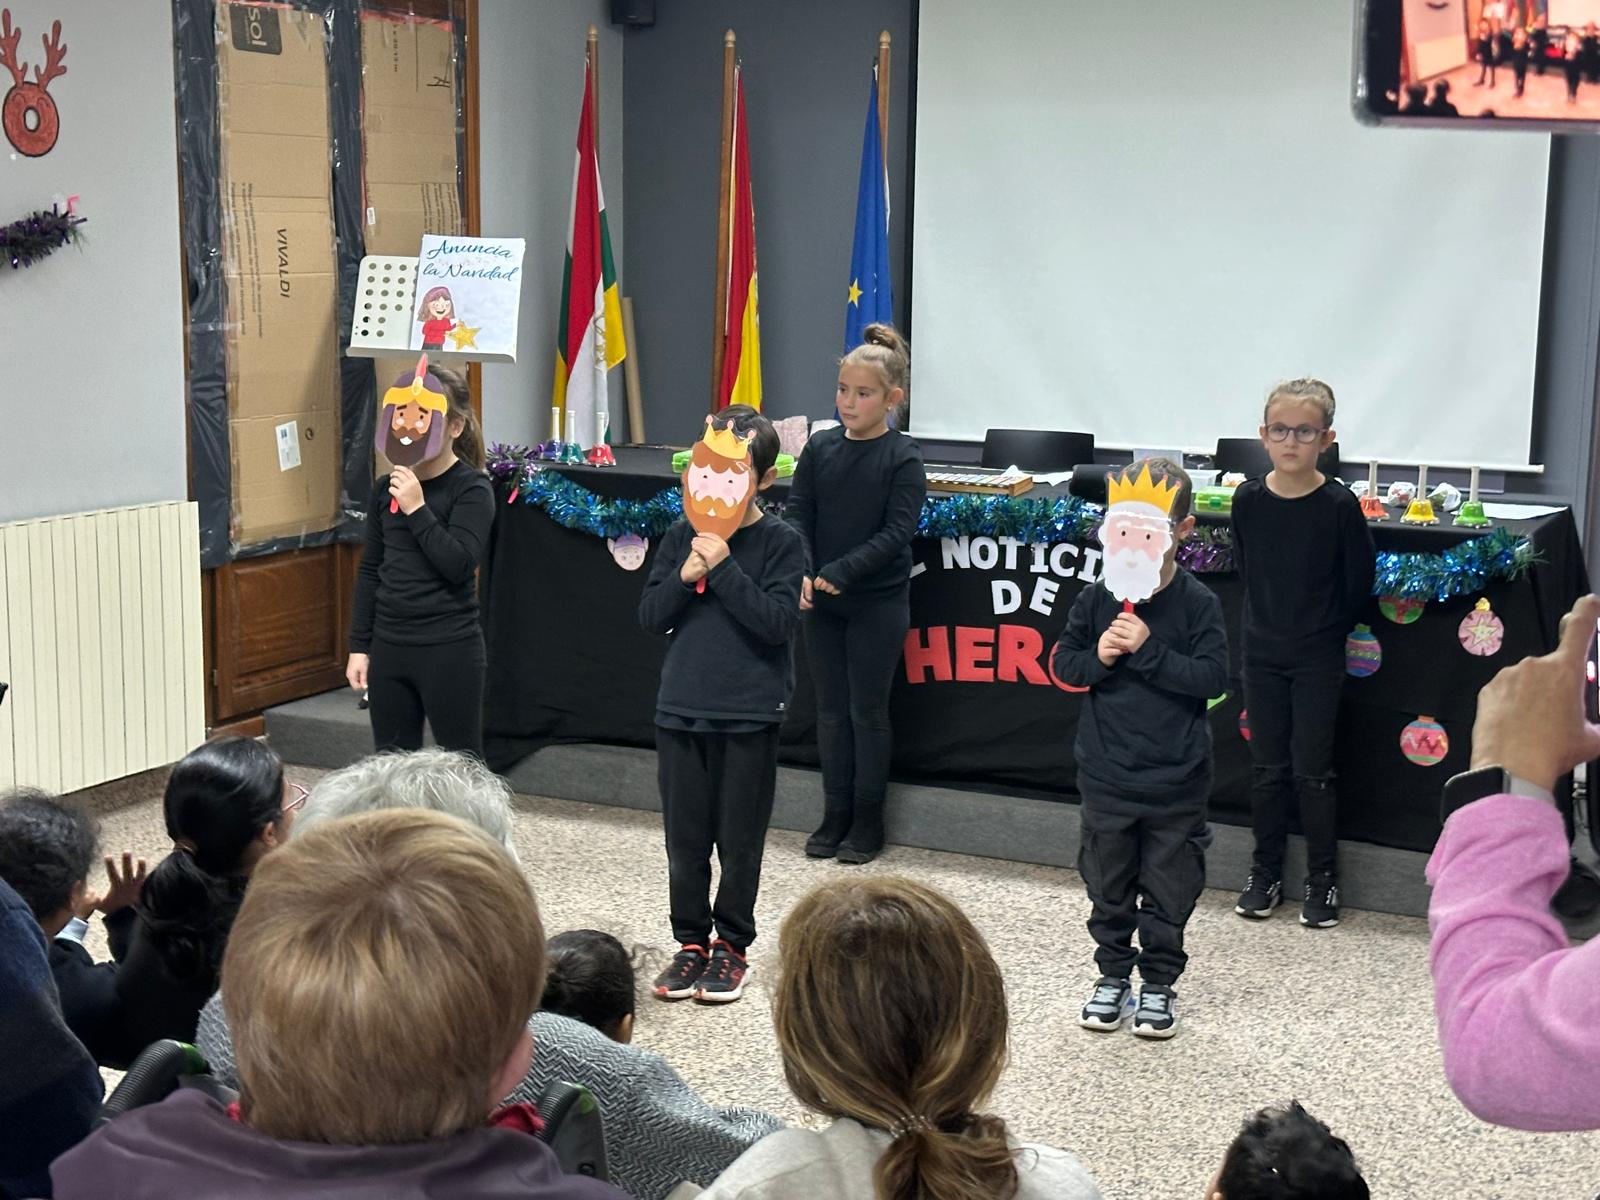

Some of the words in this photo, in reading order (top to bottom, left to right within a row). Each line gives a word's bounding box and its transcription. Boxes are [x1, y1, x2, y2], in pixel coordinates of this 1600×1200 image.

[276, 228, 291, 299] VIVALDI
[426, 239, 514, 260] Anuncia
[422, 263, 441, 277] la
[440, 264, 520, 282] Navidad
[941, 535, 1104, 583] NOTICI
[991, 576, 1060, 616] DE
